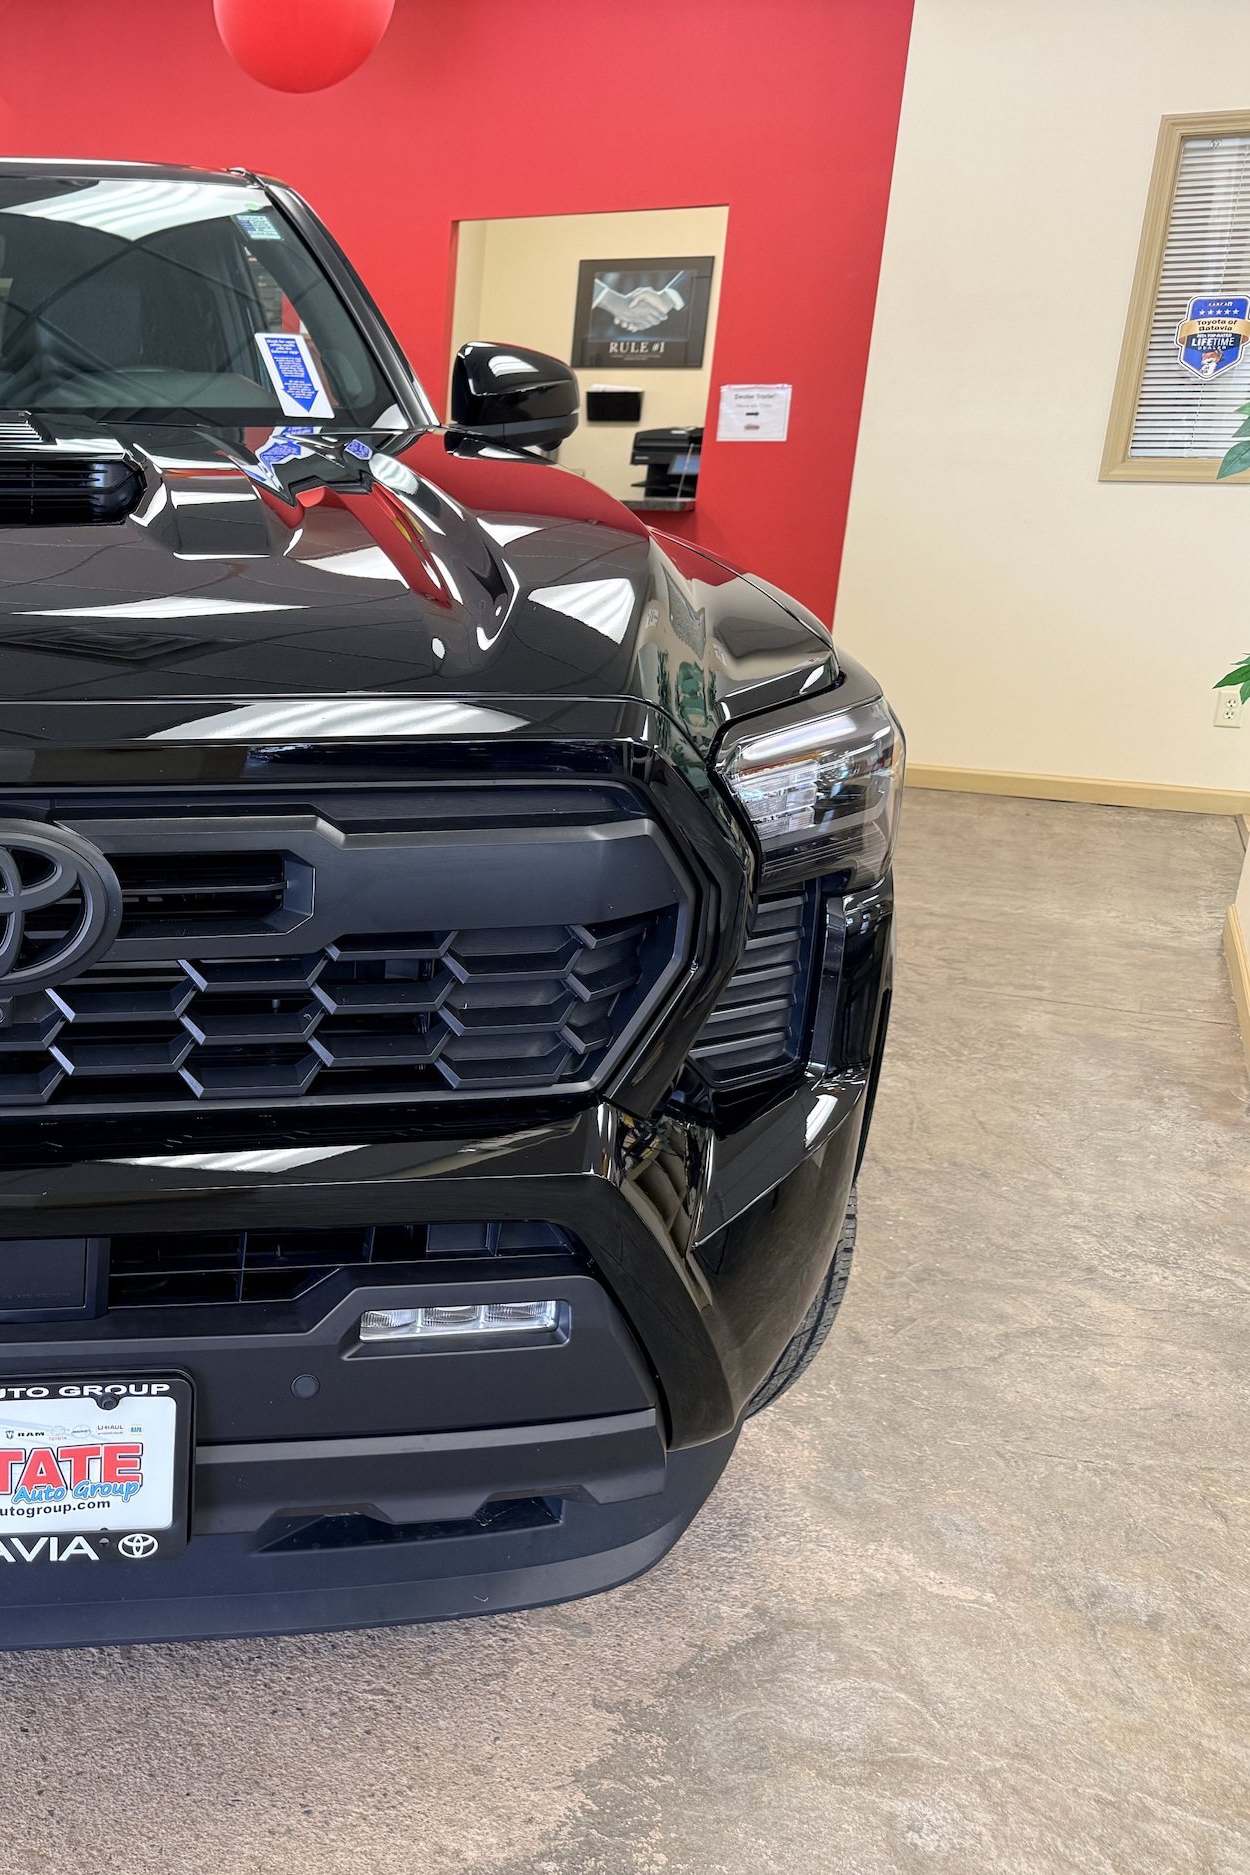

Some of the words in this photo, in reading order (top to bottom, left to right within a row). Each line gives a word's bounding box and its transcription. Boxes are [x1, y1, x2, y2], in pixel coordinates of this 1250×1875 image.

[609, 341, 649, 353] RULE
[651, 341, 665, 353] #1
[1191, 337, 1235, 347] LIFETIME
[59, 1383, 171, 1398] GROUP
[12, 1484, 66, 1504] Auto
[71, 1479, 141, 1502] Group
